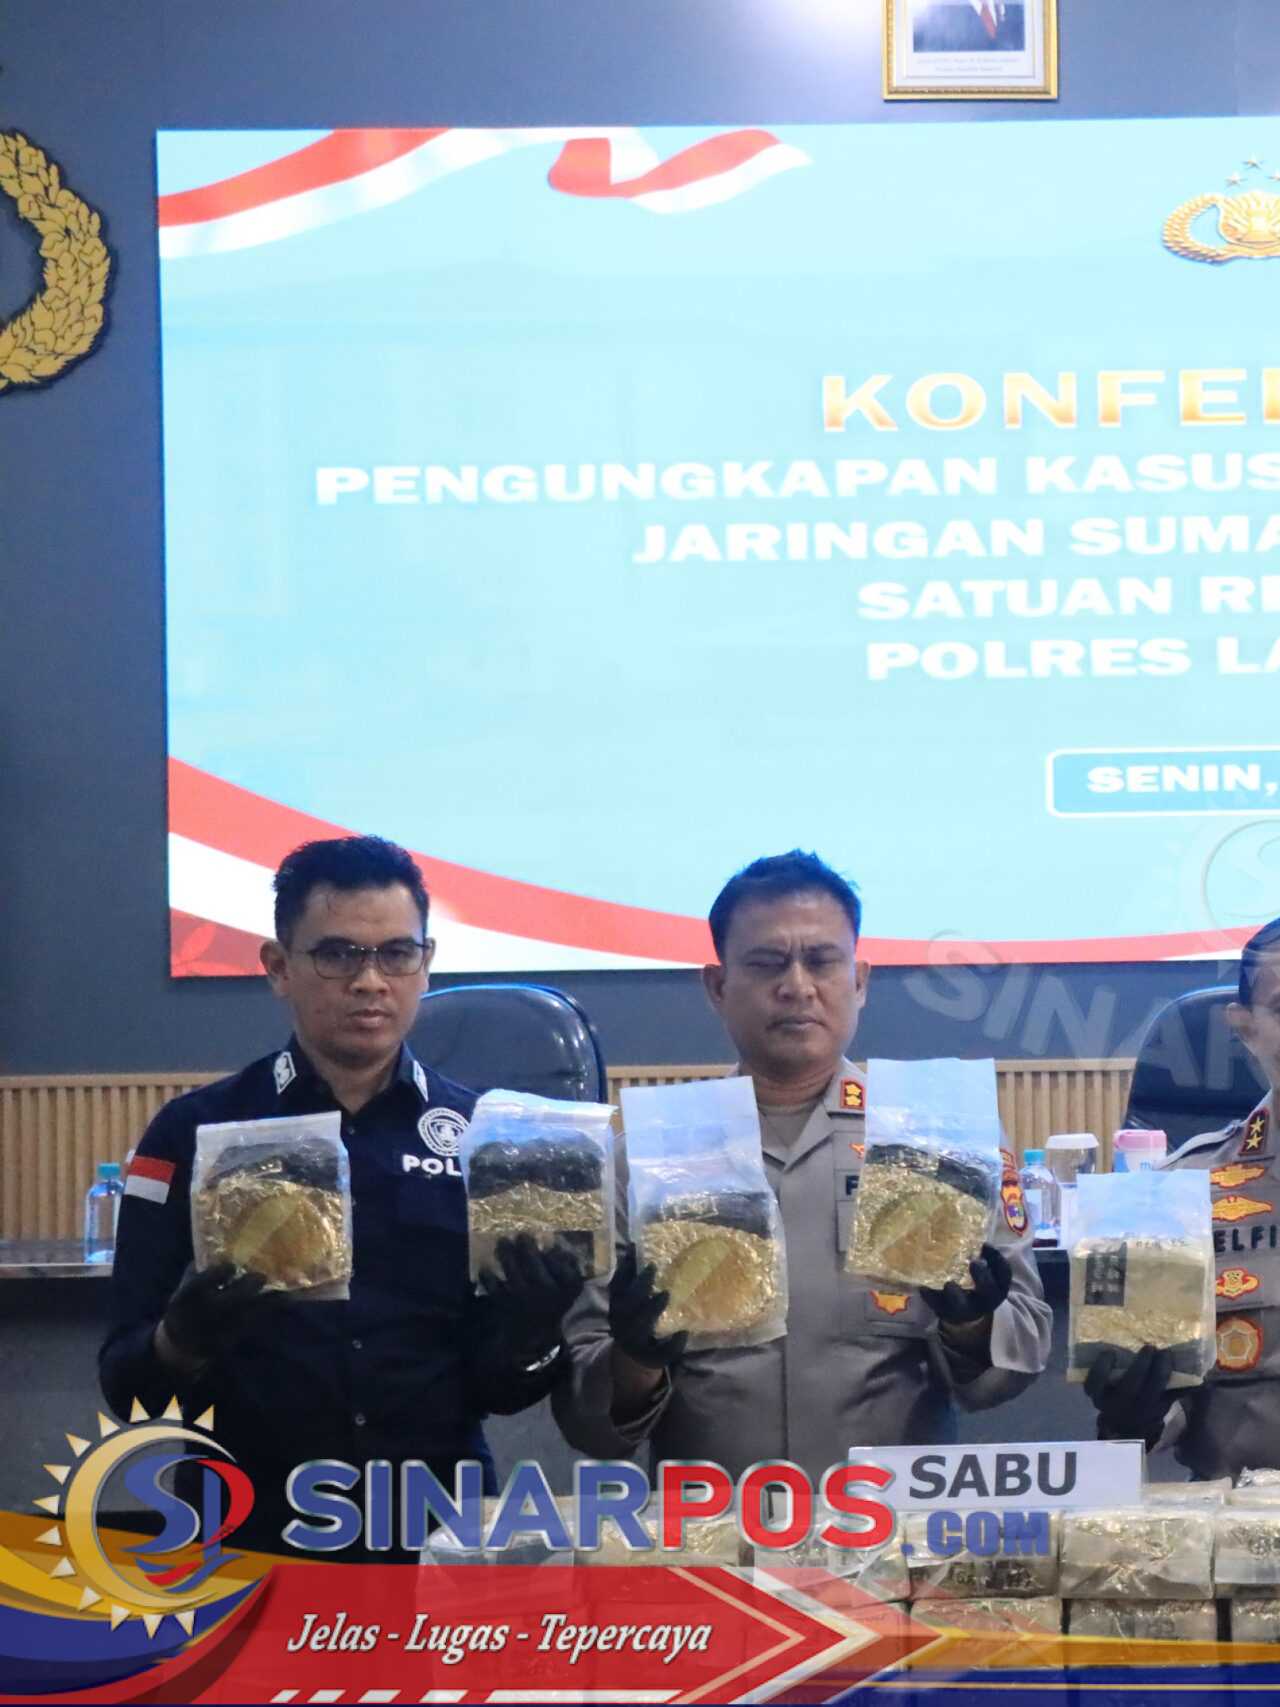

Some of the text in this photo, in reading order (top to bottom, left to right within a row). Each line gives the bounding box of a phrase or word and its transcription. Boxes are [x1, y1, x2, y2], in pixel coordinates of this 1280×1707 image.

[315, 457, 998, 505] PENGUNGKAPAN
[632, 518, 1045, 564] JARINGAN
[857, 576, 1173, 620] SATUAN
[866, 637, 1192, 680] POLRES
[1086, 763, 1279, 797] SENIN,
[908, 1451, 1077, 1500] SABU
